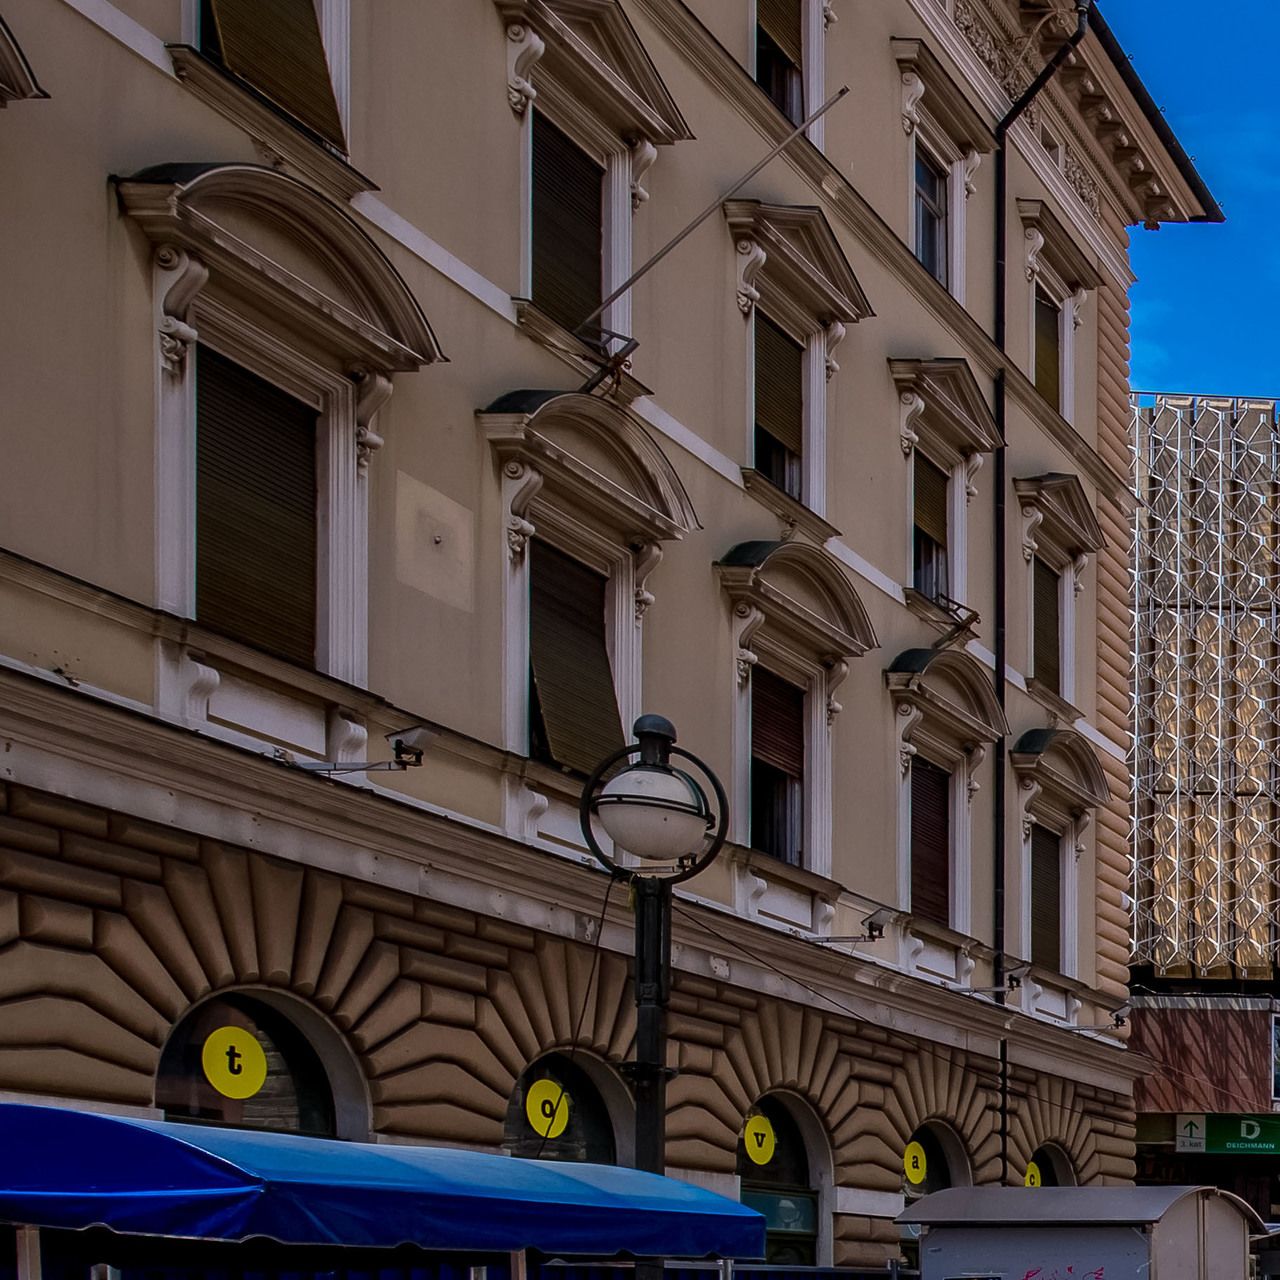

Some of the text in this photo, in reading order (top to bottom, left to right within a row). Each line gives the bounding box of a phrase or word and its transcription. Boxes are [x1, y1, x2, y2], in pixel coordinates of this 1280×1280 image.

[225, 1045, 243, 1075] t
[541, 1099, 555, 1119] o
[753, 1131, 767, 1148] v
[911, 1155, 920, 1170] a
[1226, 1141, 1275, 1149] DEICHMANN
